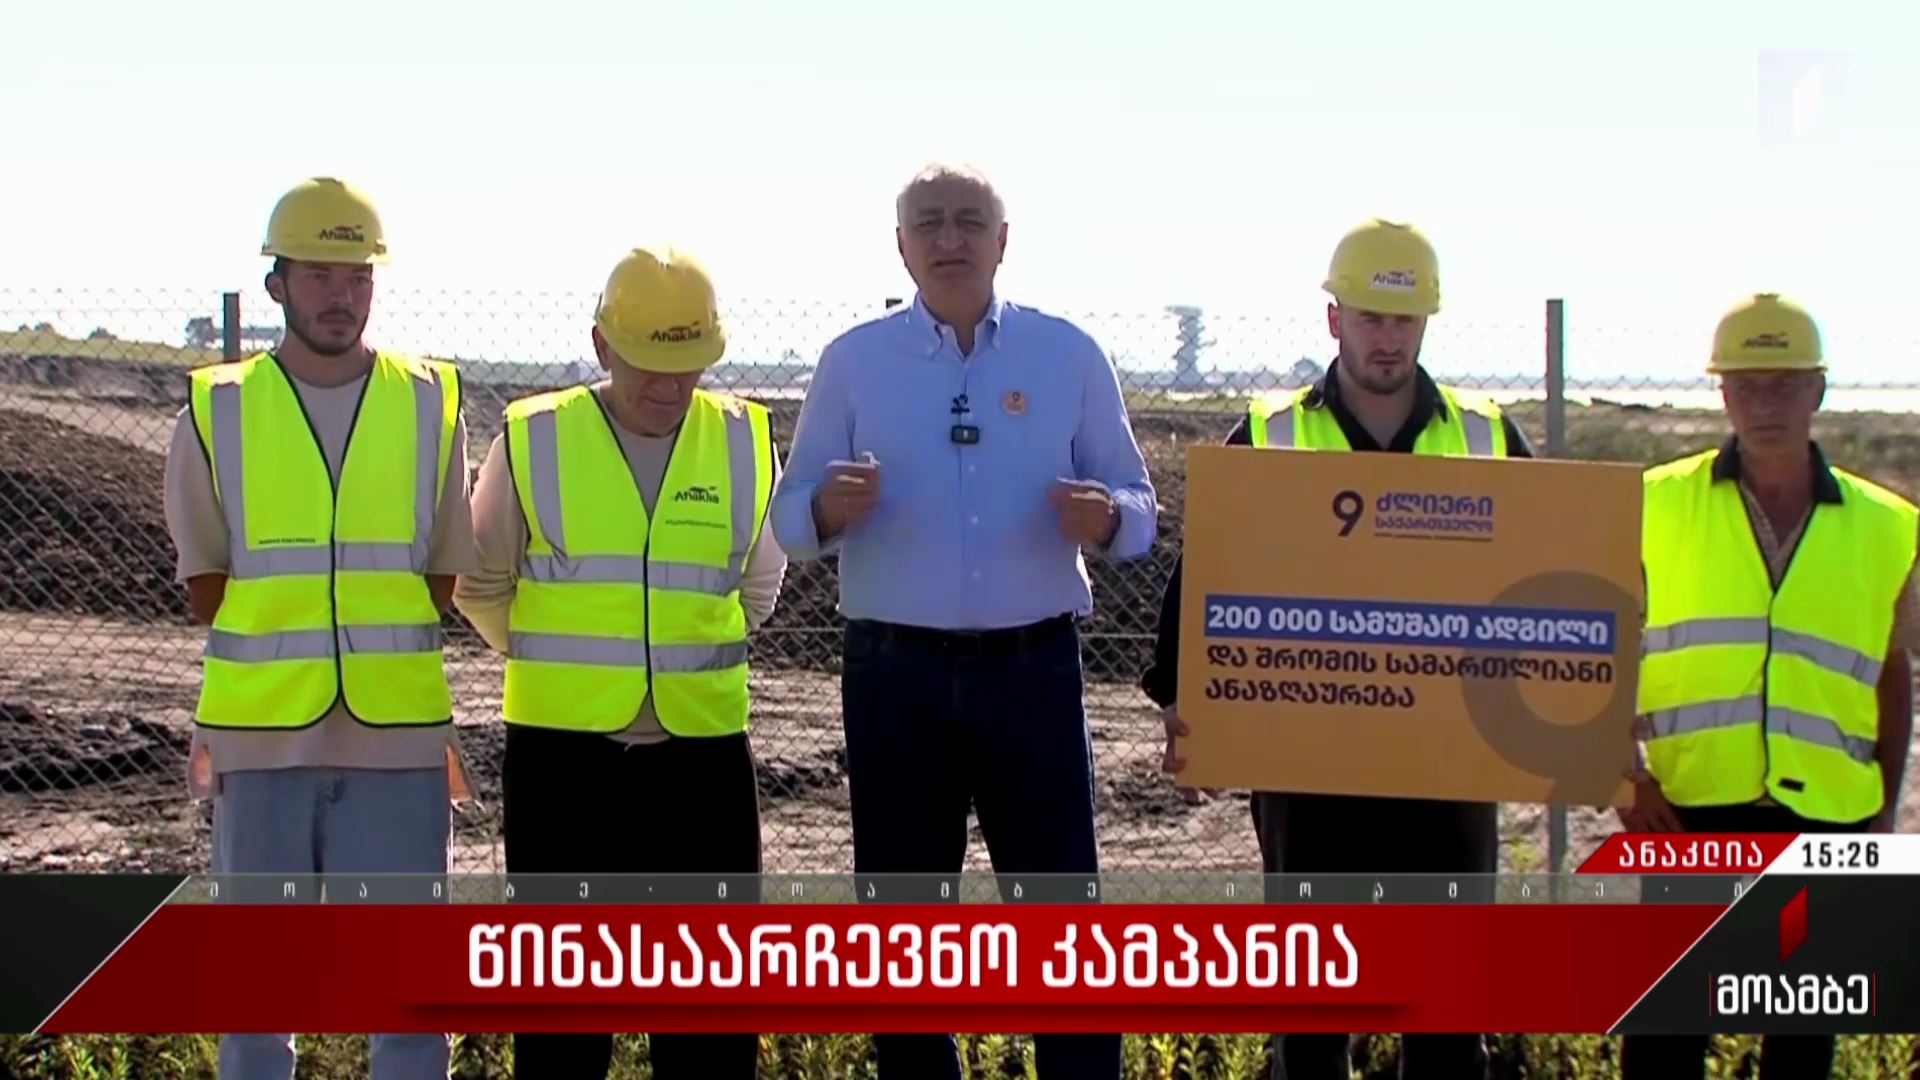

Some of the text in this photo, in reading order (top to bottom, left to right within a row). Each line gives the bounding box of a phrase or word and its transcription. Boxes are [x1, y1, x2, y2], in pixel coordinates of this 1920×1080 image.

[1332, 490, 1364, 537] 9
[1376, 493, 1494, 516] ძლიერი
[1208, 604, 1609, 645] 200 000 სამუშაო ადგილი
[1207, 644, 1613, 684] და შრომის სამართლიანი
[1205, 677, 1416, 709] ანაზღაურება
